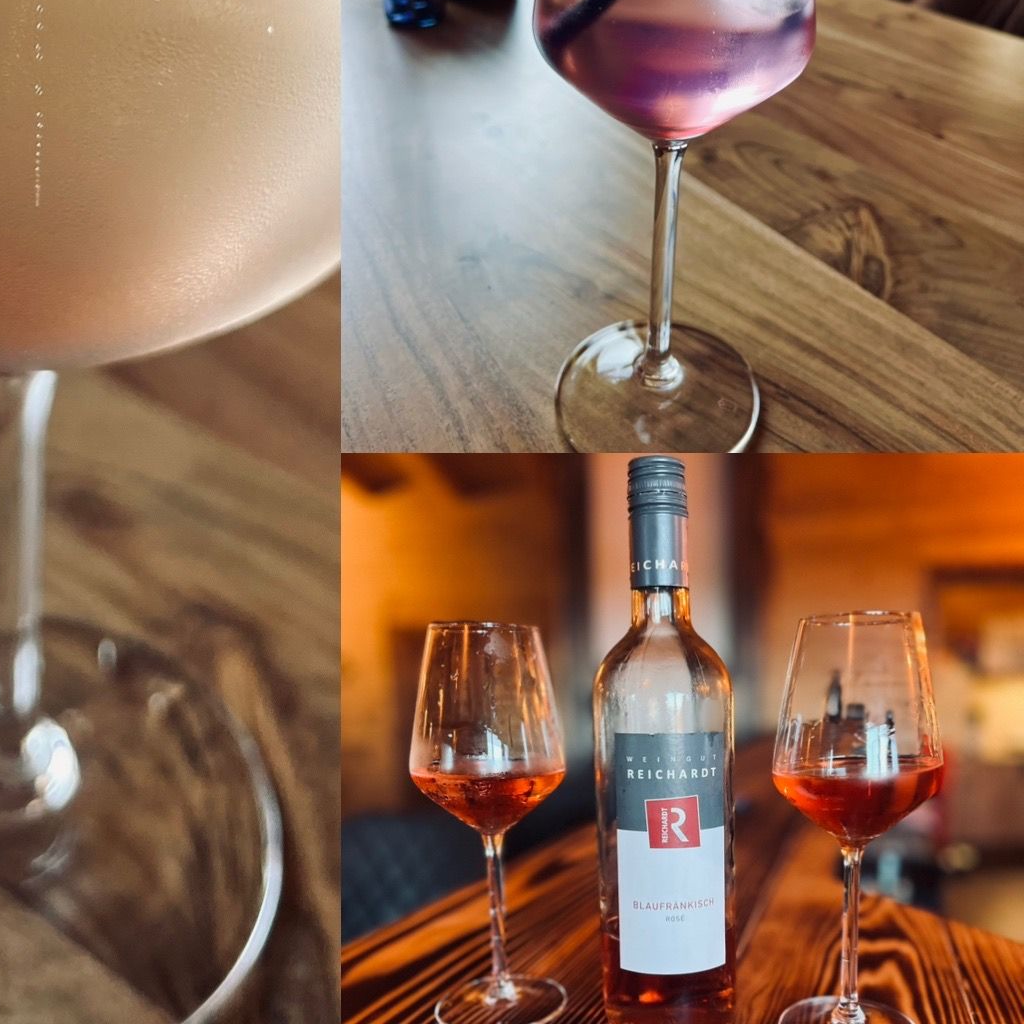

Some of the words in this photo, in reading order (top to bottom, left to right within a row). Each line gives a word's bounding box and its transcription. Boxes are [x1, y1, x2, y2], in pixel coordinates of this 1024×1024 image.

[626, 754, 717, 763] WEINGUT
[627, 767, 717, 779] REICHARDT
[670, 807, 689, 842] R
